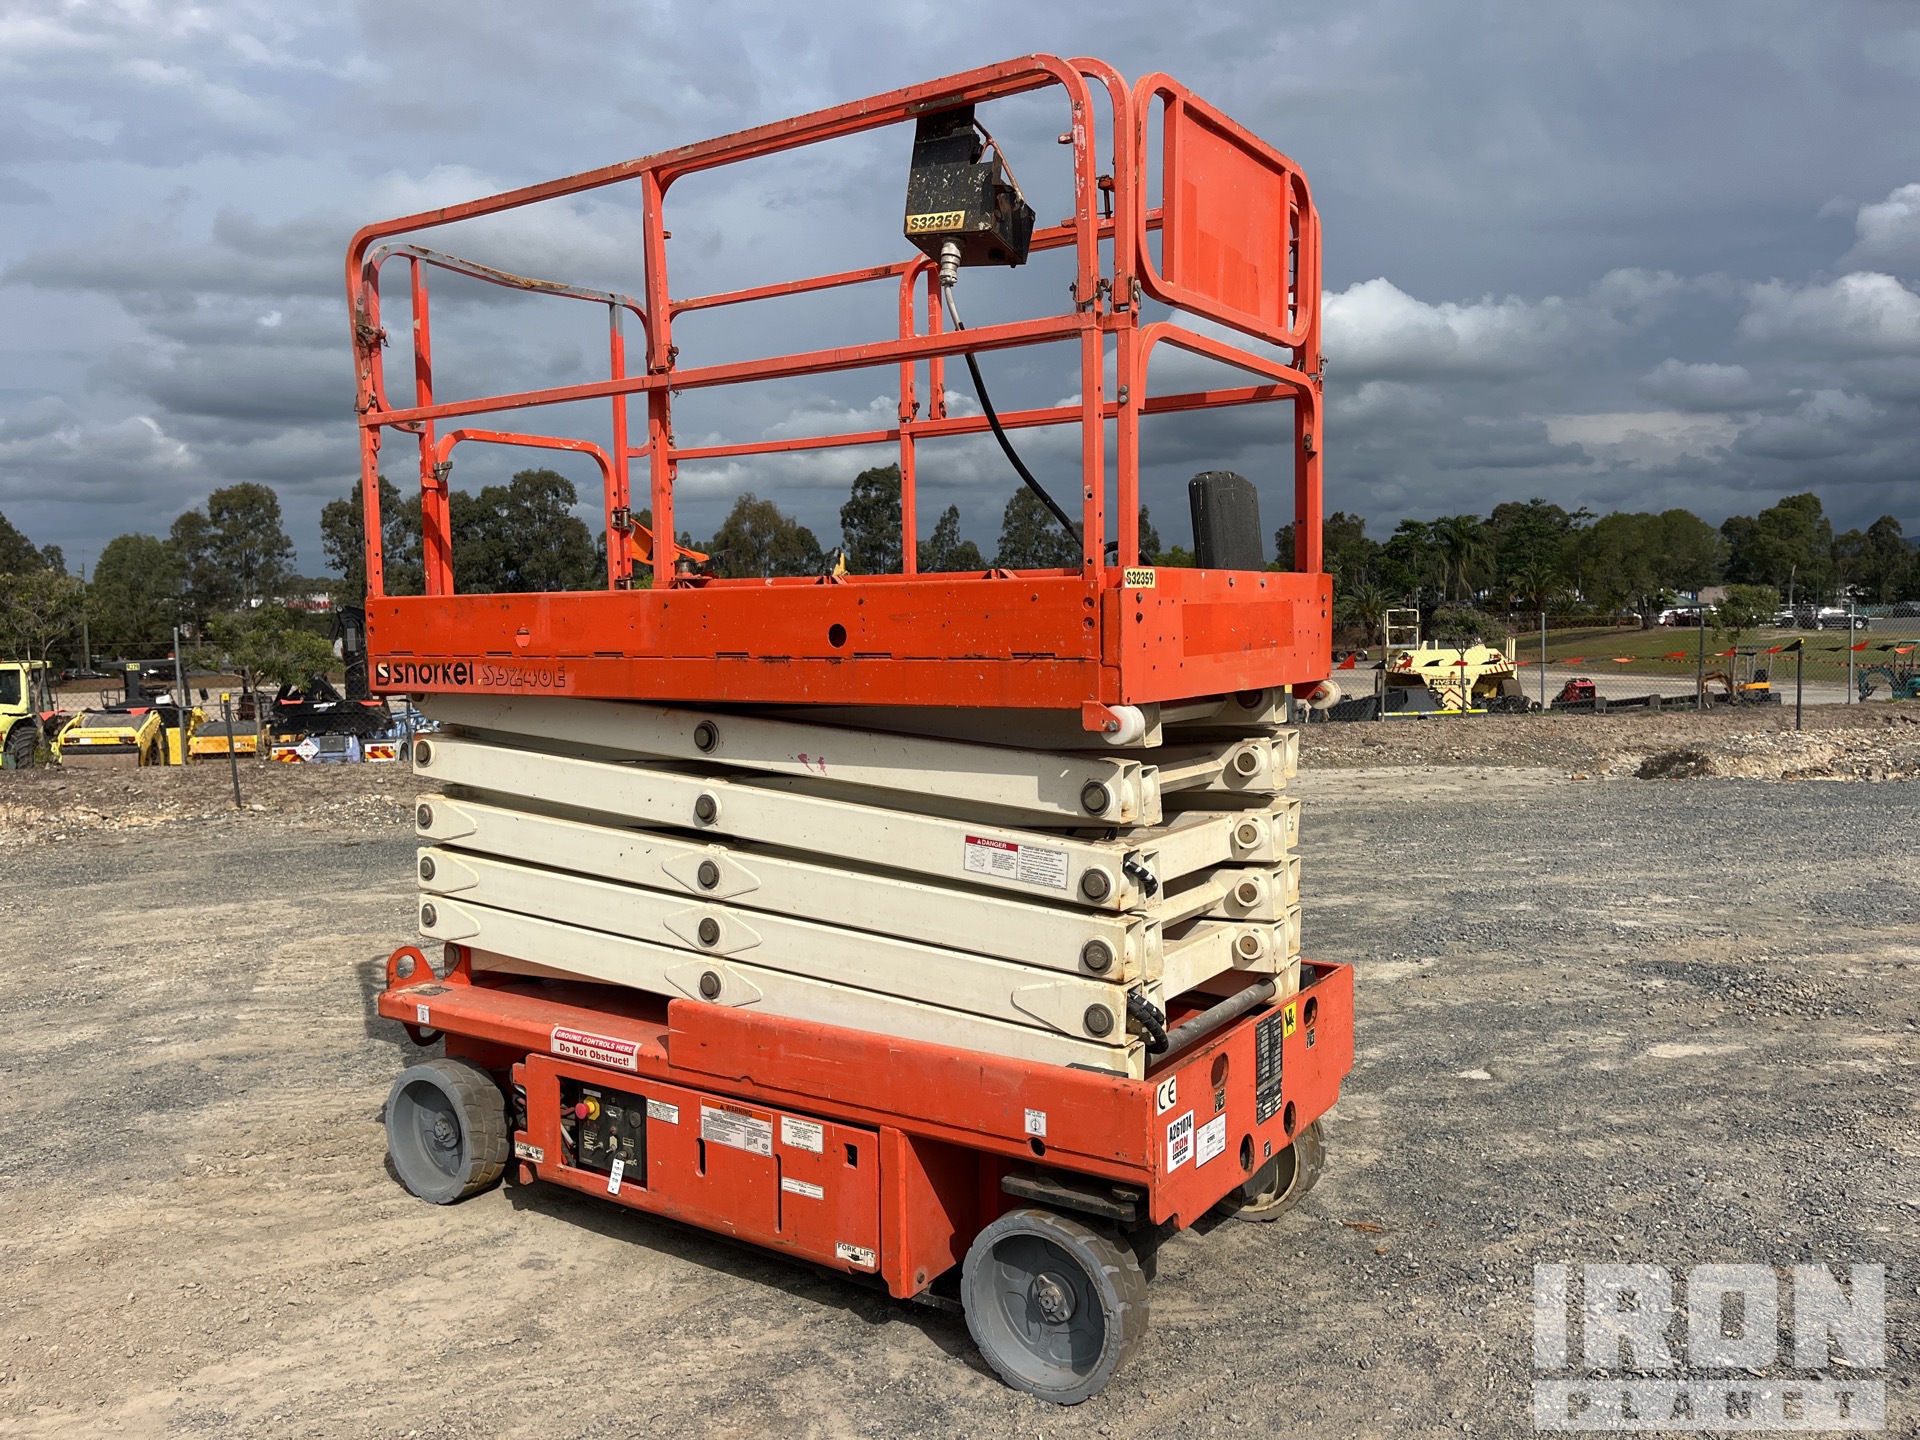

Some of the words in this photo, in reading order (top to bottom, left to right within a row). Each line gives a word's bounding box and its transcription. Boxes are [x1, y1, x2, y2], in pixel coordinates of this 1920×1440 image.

[910, 213, 962, 230] S32359
[1126, 571, 1154, 585] S32359
[393, 660, 473, 685] snorkel
[980, 839, 1007, 849] DANGER
[556, 1031, 582, 1042] GROUND
[582, 1037, 615, 1050] CONTROLS
[616, 1044, 634, 1053] HERE
[559, 1043, 570, 1053] Do
[572, 1045, 587, 1057] Not
[589, 1050, 629, 1066] Obstruct!
[1158, 1078, 1176, 1110] CE
[725, 1104, 753, 1117] WARNING
[1169, 1114, 1192, 1143] A261074
[1172, 1134, 1188, 1154] IRON
[837, 1242, 857, 1253] FORK
[859, 1248, 876, 1259] LIFT
